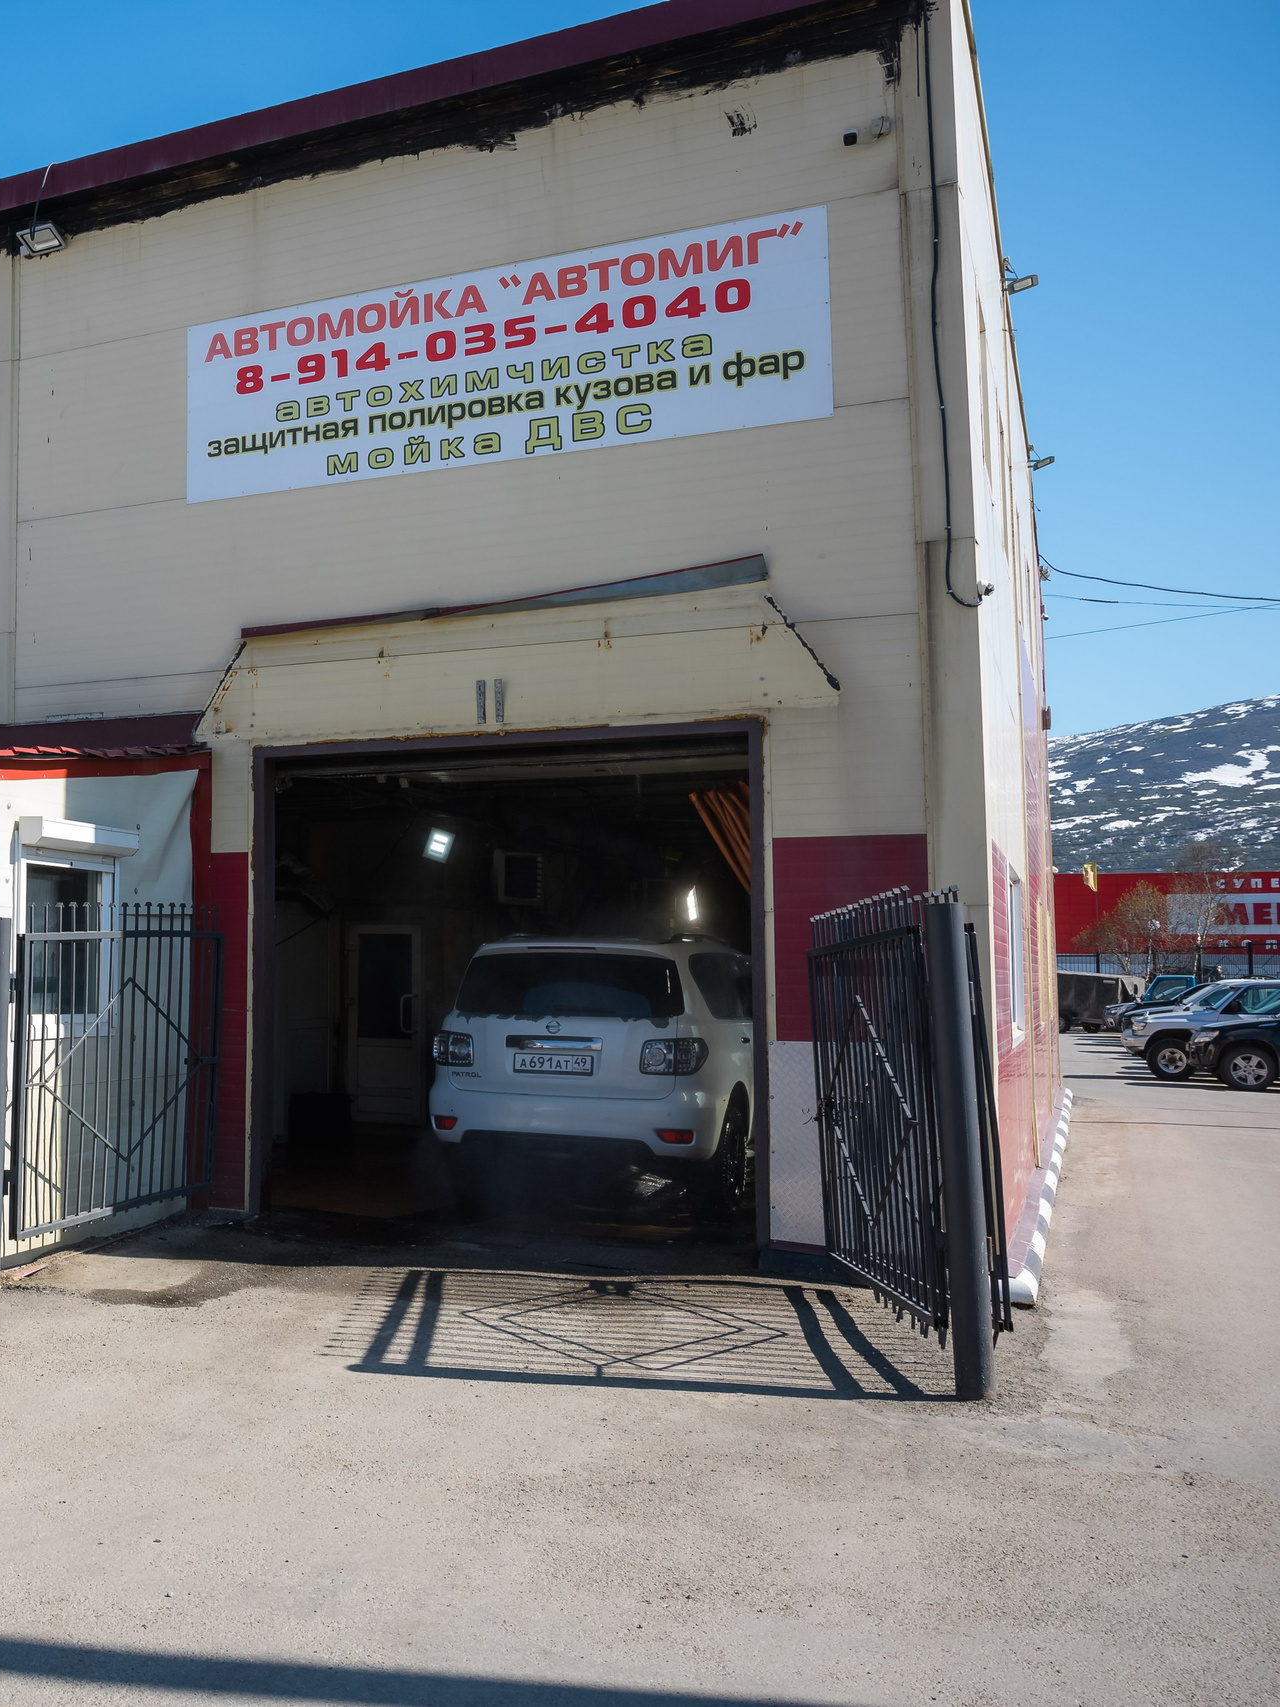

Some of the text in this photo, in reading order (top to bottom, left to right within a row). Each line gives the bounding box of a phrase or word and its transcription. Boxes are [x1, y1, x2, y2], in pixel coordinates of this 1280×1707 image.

[204, 285, 488, 363] АВТОМОЙКА
[235, 278, 751, 395] 8-914-035-4040
[206, 346, 806, 459] защитная полировка кузова и фар
[275, 333, 714, 422] автохимчистка
[326, 403, 653, 476] мойка ДВС
[451, 1070, 482, 1078] PATROL
[574, 1057, 587, 1067] 49
